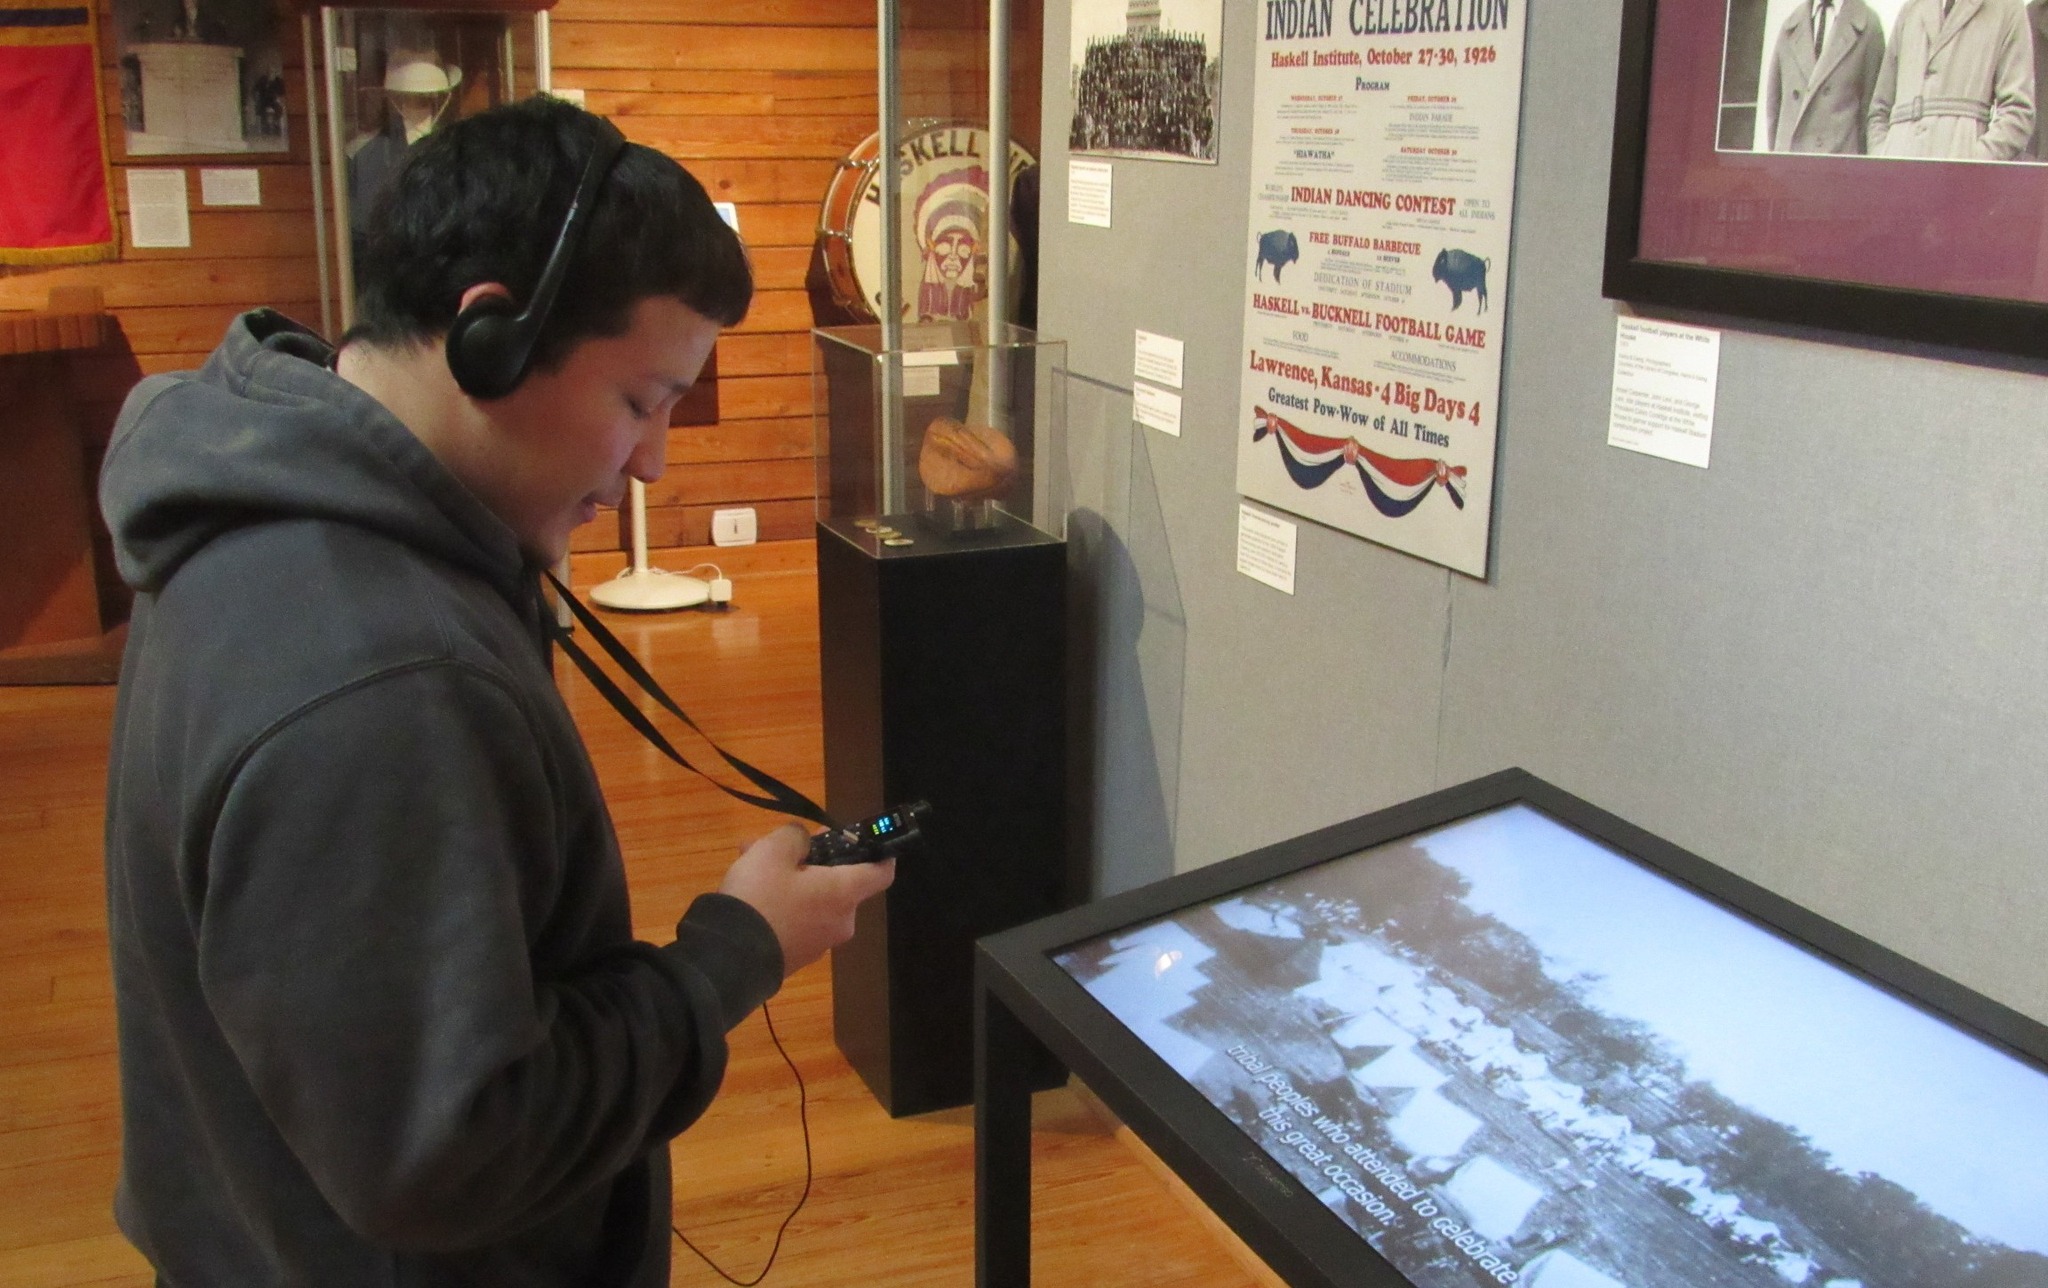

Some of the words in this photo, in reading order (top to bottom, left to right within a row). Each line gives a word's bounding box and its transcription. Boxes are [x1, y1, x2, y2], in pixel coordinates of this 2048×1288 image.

[1265, 0, 1332, 40] INDIAN
[1349, 0, 1509, 36] CELEBRATION
[1271, 51, 1308, 68] Haskell
[1312, 49, 1362, 67] Institute,
[1367, 49, 1412, 66] October
[1464, 46, 1497, 65] 1926
[866, 131, 980, 208] HSKELL
[1291, 186, 1332, 205] INDIAN
[1336, 188, 1391, 210] DANCING
[1395, 194, 1457, 216] CONTEST
[1309, 231, 1330, 245] FREE
[1333, 234, 1370, 250] BUFFALO
[1373, 238, 1421, 256] BARBECUE
[1314, 271, 1359, 287] DEDICATION
[1362, 278, 1371, 290] OF
[1375, 280, 1412, 296] STADIUM
[1253, 293, 1299, 316] HASKELL
[1311, 302, 1372, 329] BUCKNELL
[1375, 313, 1441, 341] FOOTBALL
[1445, 325, 1486, 348] GAME
[1390, 350, 1456, 371] ACCOMMODATIONS
[1249, 350, 1318, 390] Lawrence,
[1320, 366, 1372, 398] Kansas
[1381, 382, 1391, 405] 4
[1393, 381, 1420, 414] Big
[1424, 388, 1465, 422] Days
[1469, 401, 1481, 426] 4
[1268, 387, 1309, 411] Greatest
[1373, 416, 1386, 433] of
[1389, 417, 1408, 438] All
[1414, 423, 1450, 448] Times
[1254, 1070, 1318, 1118] peoples
[1312, 1115, 1351, 1144] who
[1344, 1142, 1422, 1202] attended
[1412, 1197, 1438, 1218] to
[1433, 1217, 1518, 1284] celebrate
[1258, 1105, 1294, 1134] this
[1279, 1129, 1333, 1168] great
[1324, 1163, 1393, 1227] occasion.
